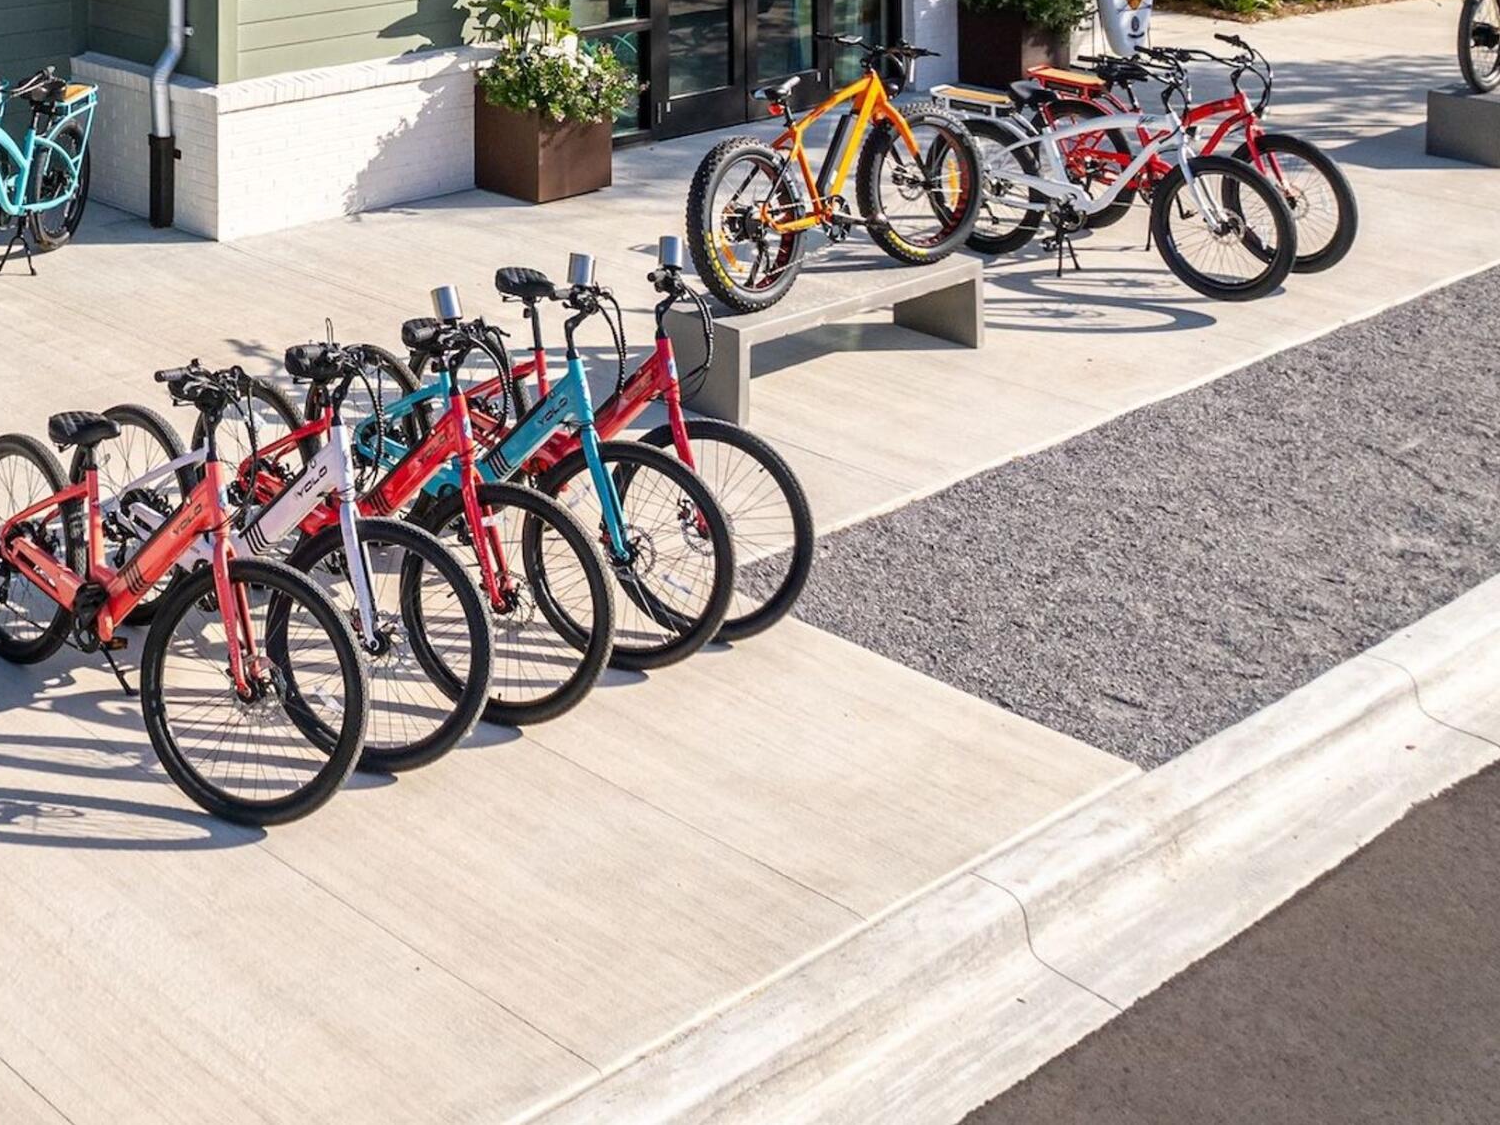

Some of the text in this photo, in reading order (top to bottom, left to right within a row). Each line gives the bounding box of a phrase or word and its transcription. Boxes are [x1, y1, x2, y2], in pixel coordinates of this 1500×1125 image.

[538, 397, 568, 425] YOLO
[296, 465, 327, 497] YOLO
[173, 503, 202, 534] YOLO
